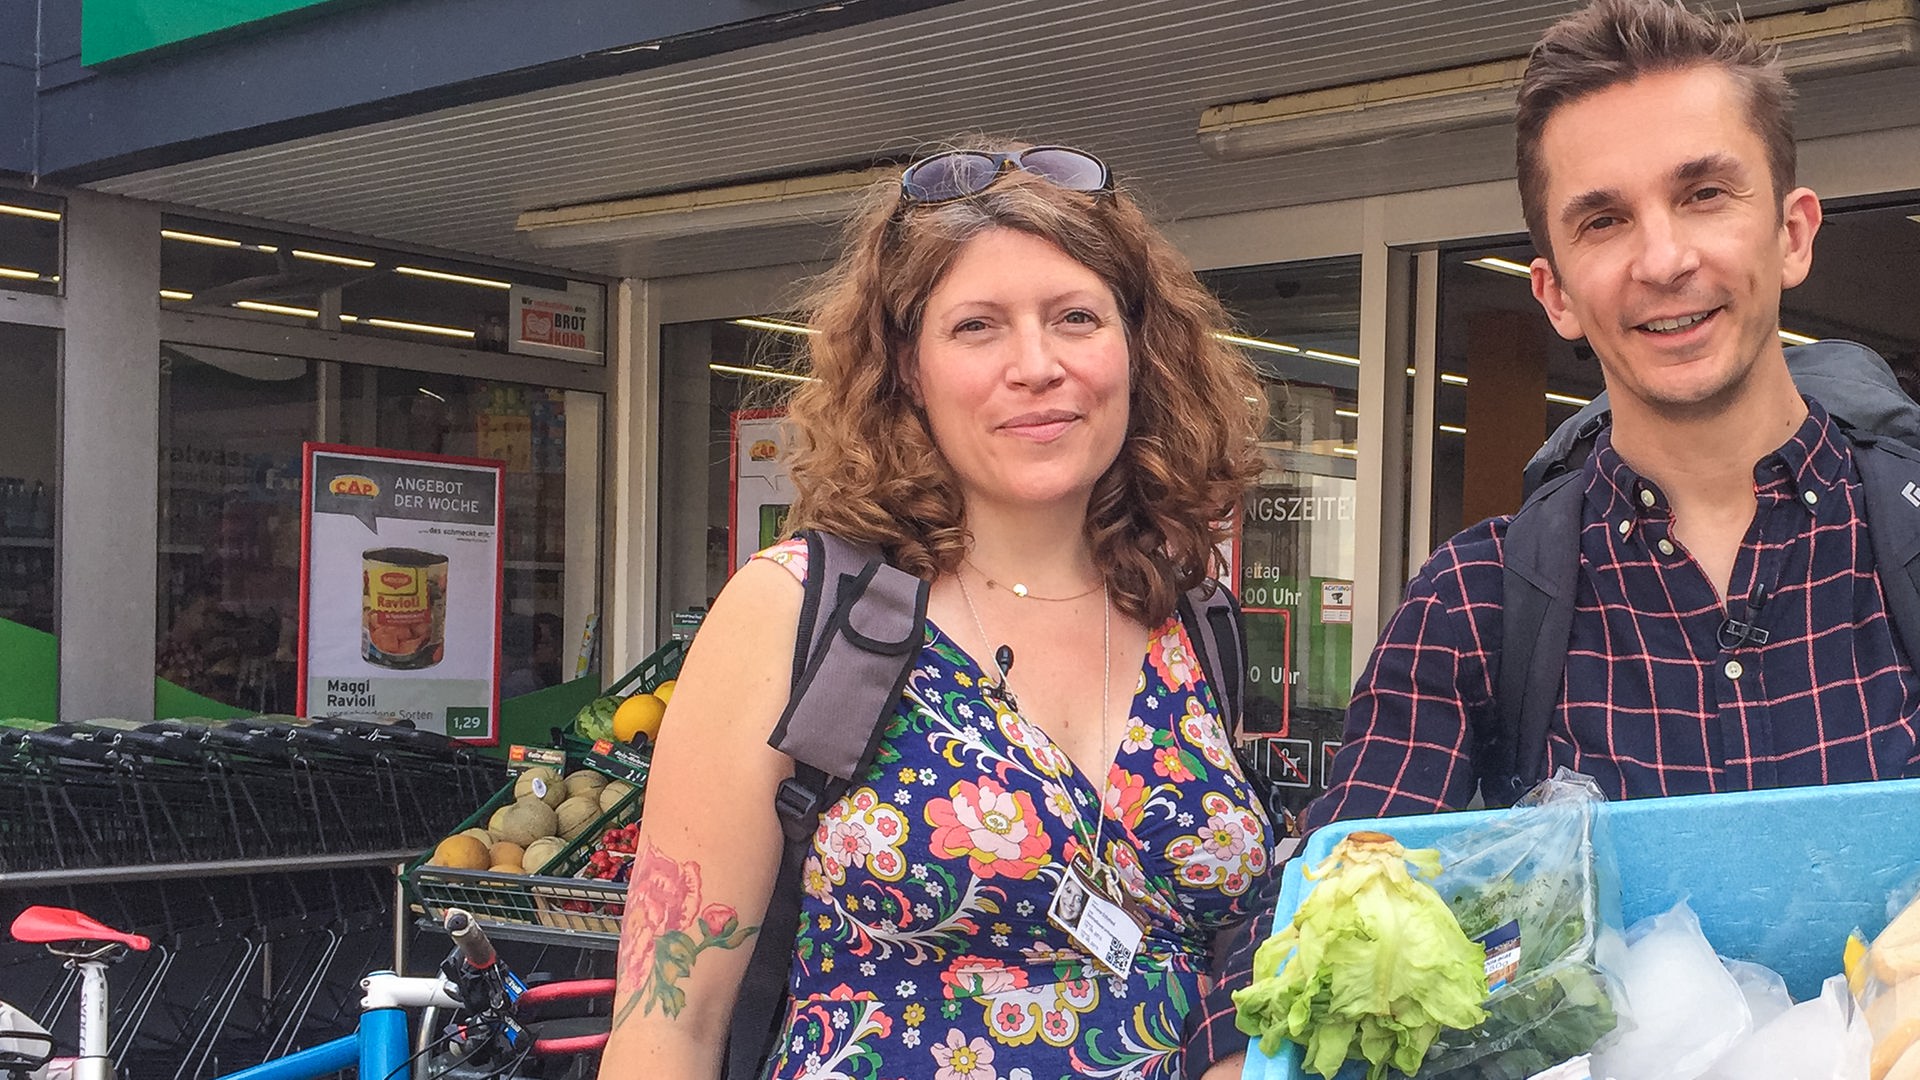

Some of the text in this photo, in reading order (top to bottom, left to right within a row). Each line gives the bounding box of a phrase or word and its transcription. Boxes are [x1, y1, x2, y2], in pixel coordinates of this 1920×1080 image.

[555, 313, 586, 331] BROT
[335, 480, 373, 496] CAP
[395, 477, 463, 495] ANGEBOT
[394, 494, 479, 513] DER WOCHE
[377, 596, 419, 609] Ravioli
[1273, 588, 1302, 605] Uhr
[1271, 667, 1300, 685] Uhr
[327, 679, 370, 695] Maggi
[327, 694, 376, 707] Ravioli
[399, 709, 433, 721] Sorten
[454, 716, 481, 730] 1,29
